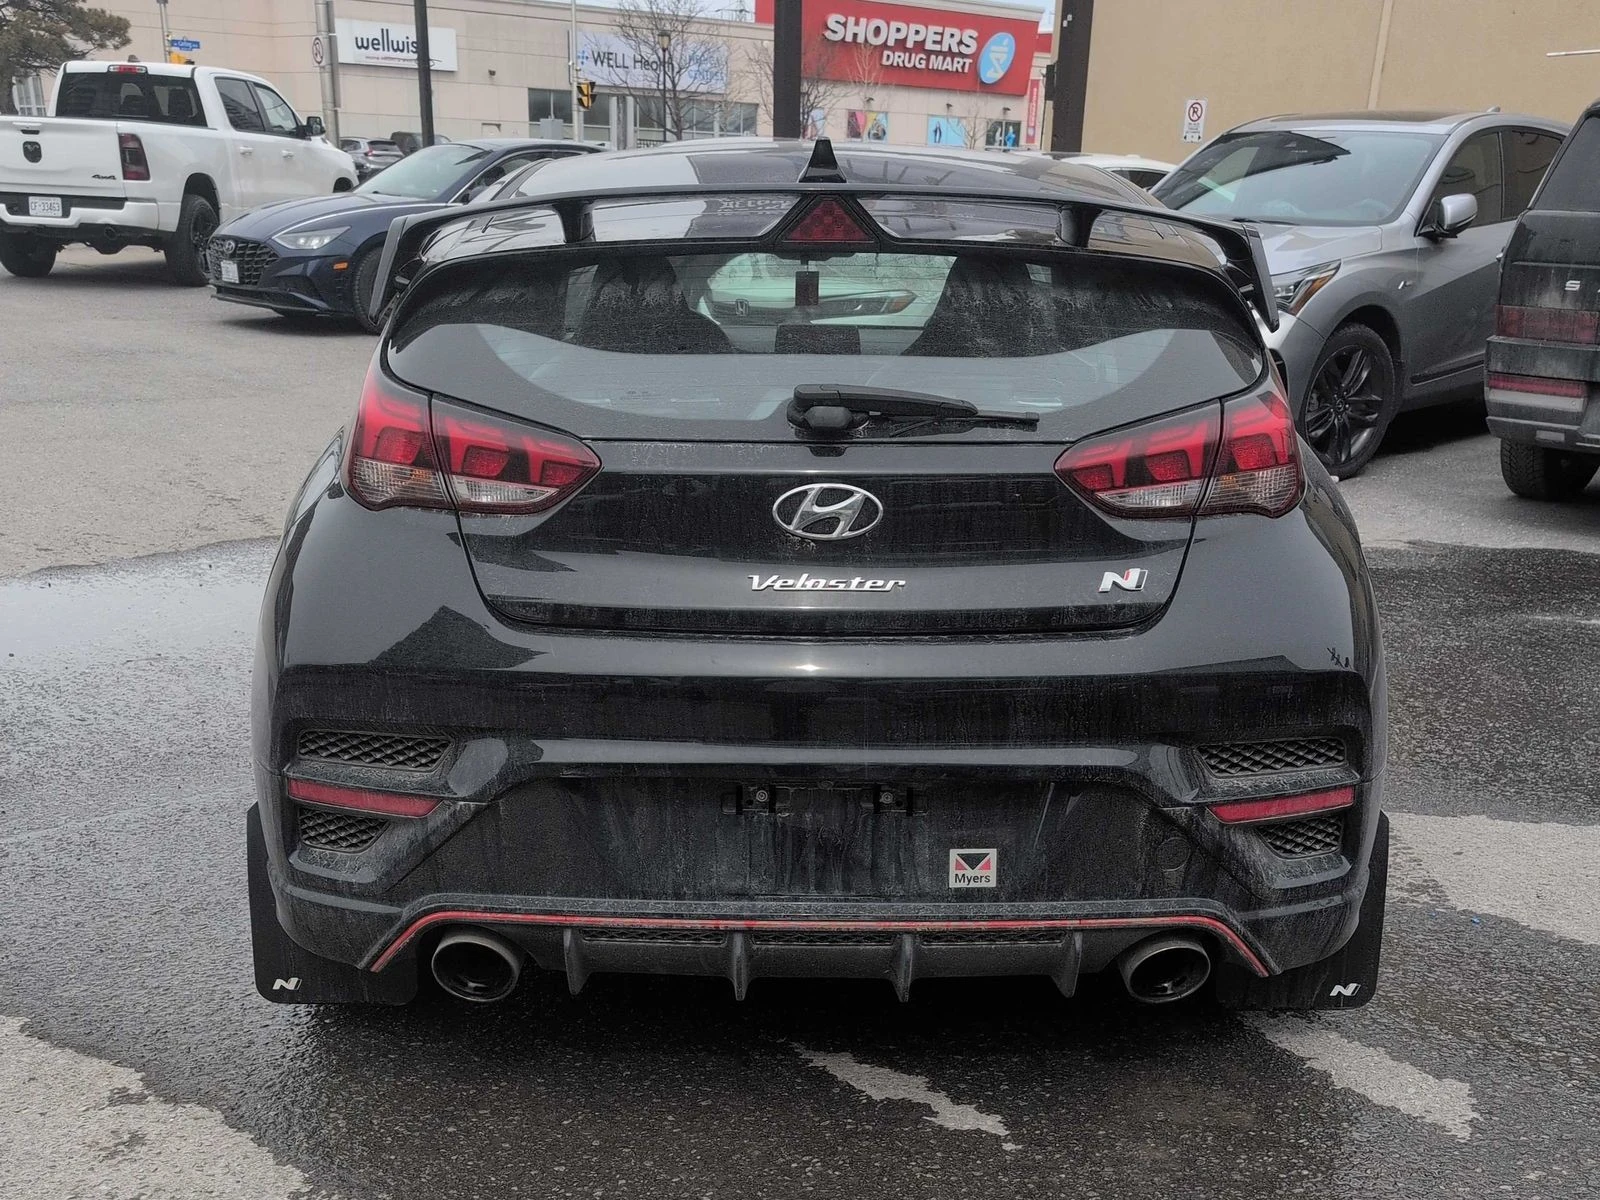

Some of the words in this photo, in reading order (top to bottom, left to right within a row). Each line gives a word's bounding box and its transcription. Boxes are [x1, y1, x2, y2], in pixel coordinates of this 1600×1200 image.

[355, 28, 419, 54] wellwis
[823, 13, 978, 55] SHOPPERS
[592, 50, 629, 69] WELL
[633, 54, 674, 72] Healh
[881, 50, 927, 70] DRUG
[929, 54, 973, 74] MART
[748, 573, 906, 592] Veloster
[954, 873, 991, 886] Myers
